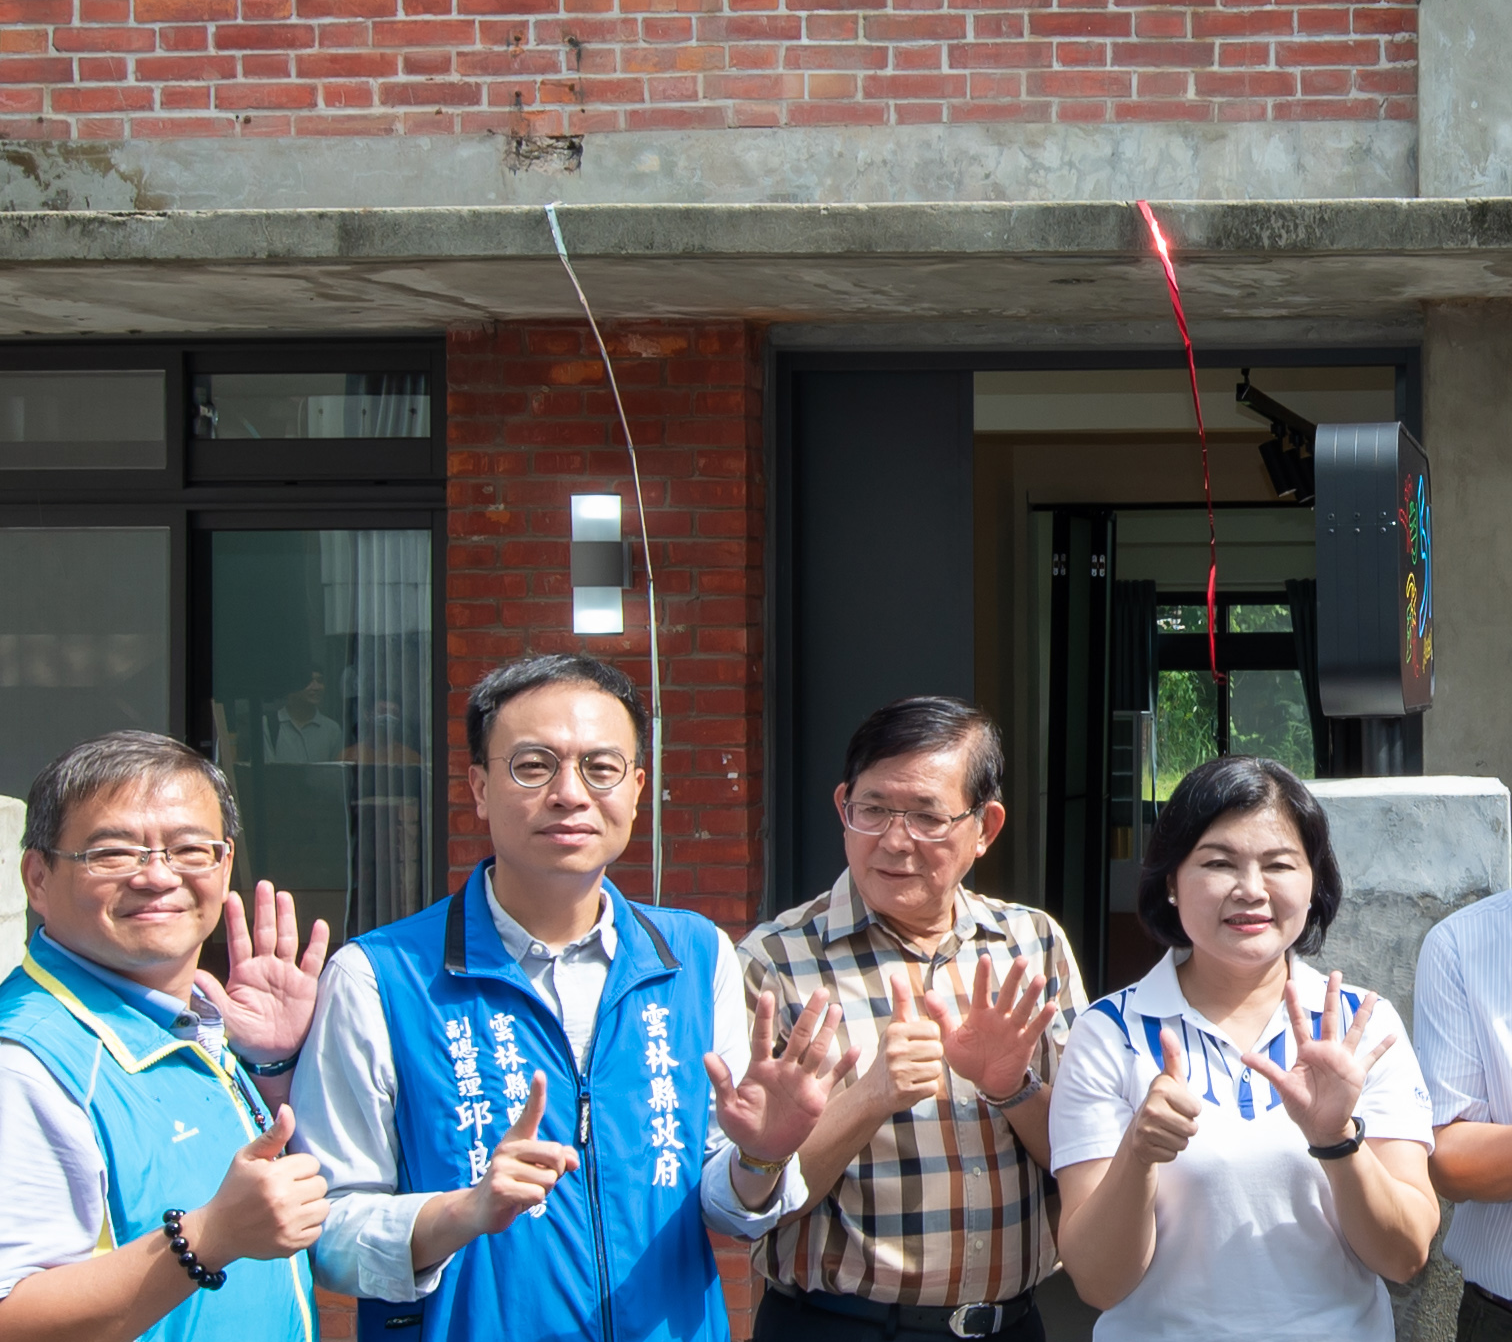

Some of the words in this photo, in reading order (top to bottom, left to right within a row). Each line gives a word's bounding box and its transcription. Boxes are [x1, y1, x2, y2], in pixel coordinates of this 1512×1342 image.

[641, 1003, 687, 1188] 雲林縣政府
